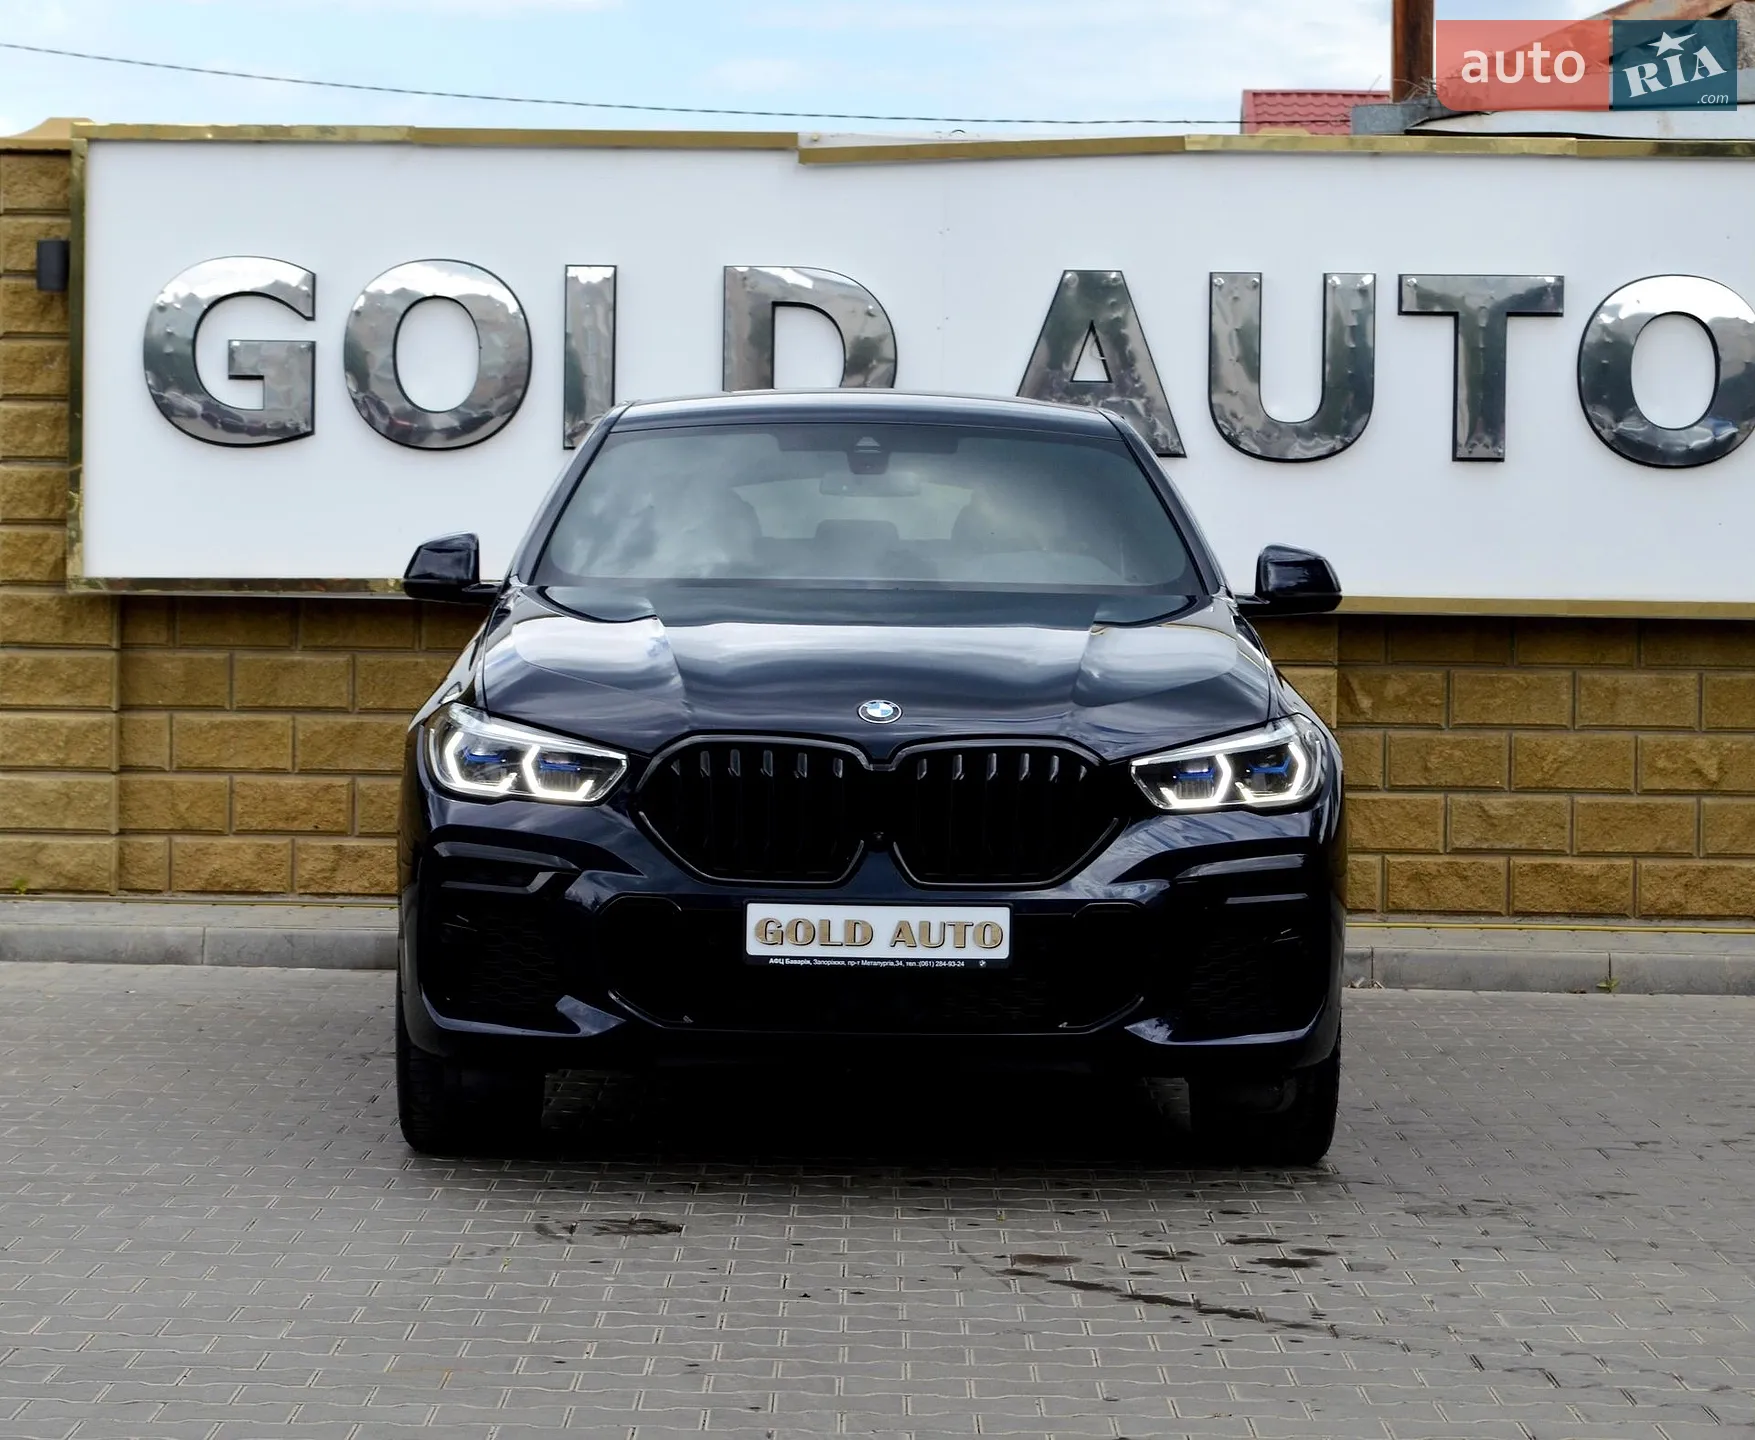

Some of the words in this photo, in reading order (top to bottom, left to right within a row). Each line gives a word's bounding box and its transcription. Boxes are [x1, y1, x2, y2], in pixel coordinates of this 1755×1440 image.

[1016, 269, 1755, 469] AUTO
[754, 917, 874, 947] GOLD
[889, 919, 1004, 949] AUTO
